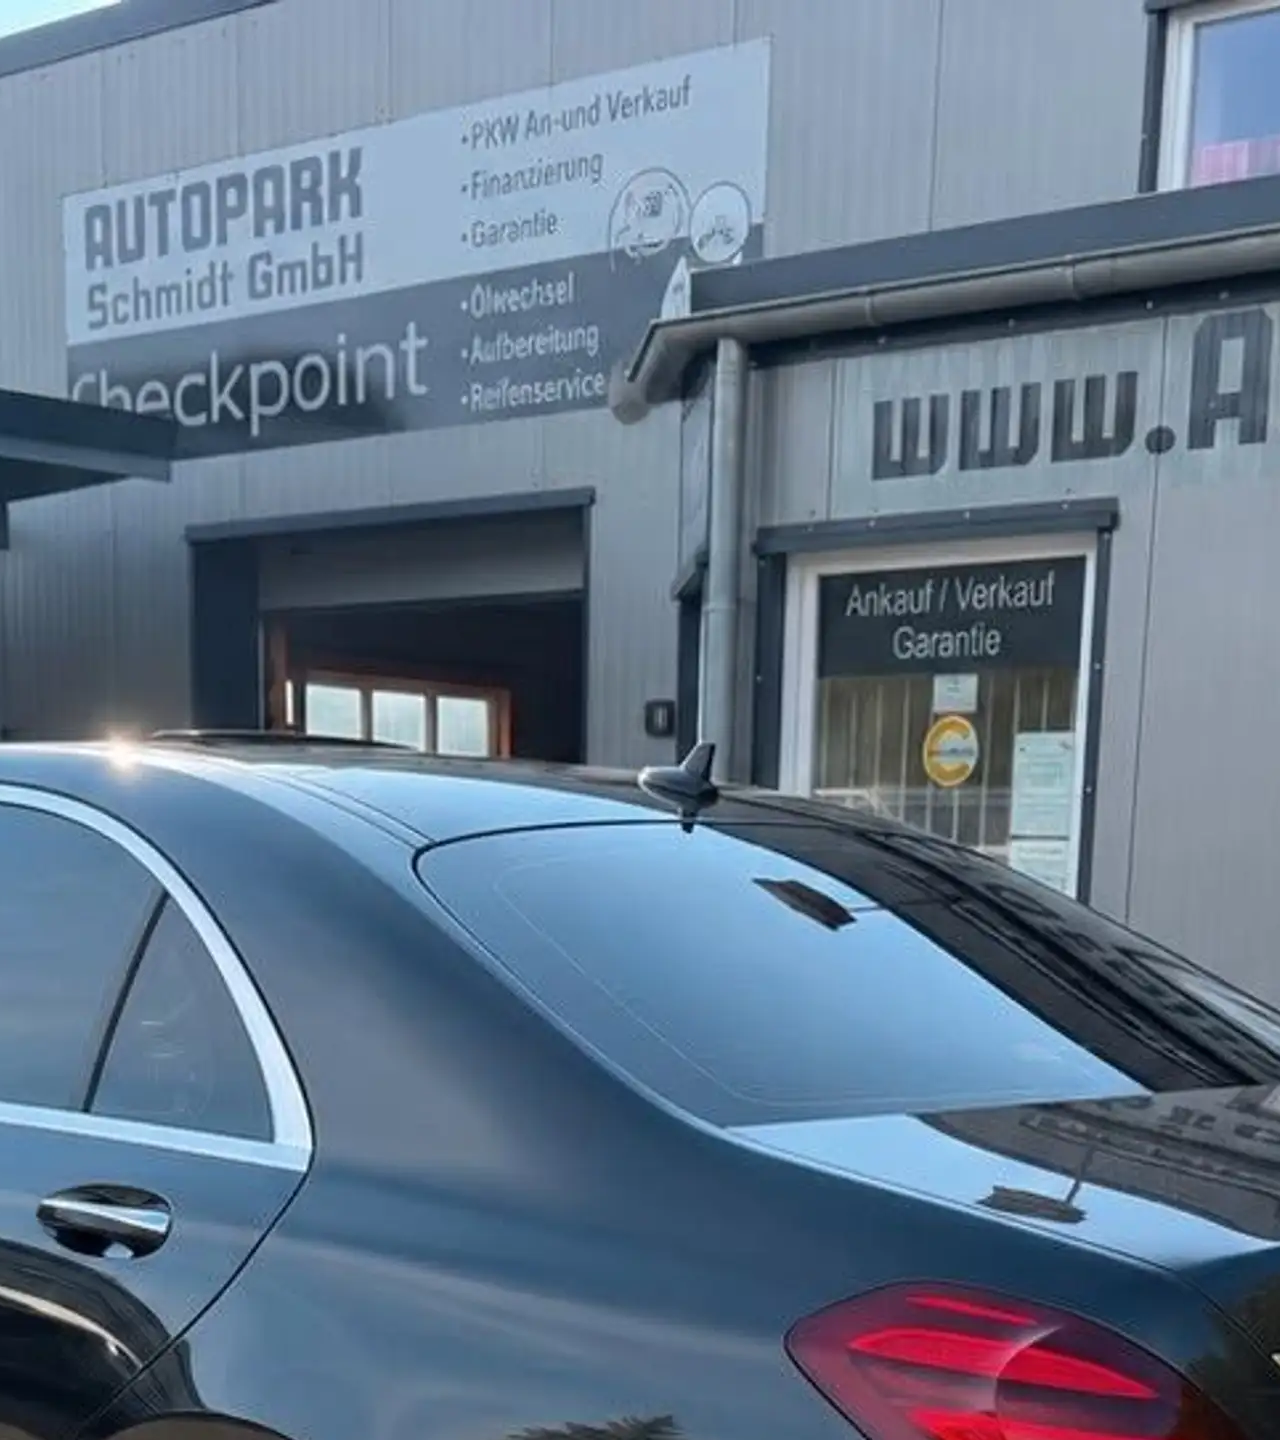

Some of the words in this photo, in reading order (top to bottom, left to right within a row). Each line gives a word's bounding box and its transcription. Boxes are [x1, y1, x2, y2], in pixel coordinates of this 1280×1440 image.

[471, 115, 518, 150] PKW
[608, 74, 690, 123] Verkauf
[471, 153, 604, 201] Finanzierung
[85, 146, 363, 273] AUTOPARK
[471, 208, 559, 248] Garantie
[87, 259, 235, 331] Schmidt
[247, 231, 363, 301] GmbH
[470, 325, 600, 365] Aufbereitung
[470, 368, 605, 411] Reifenservice
[845, 577, 933, 617] Ankauf
[939, 577, 949, 613] /
[954, 570, 1055, 612] Verkauf
[893, 622, 1001, 660] Garantie
